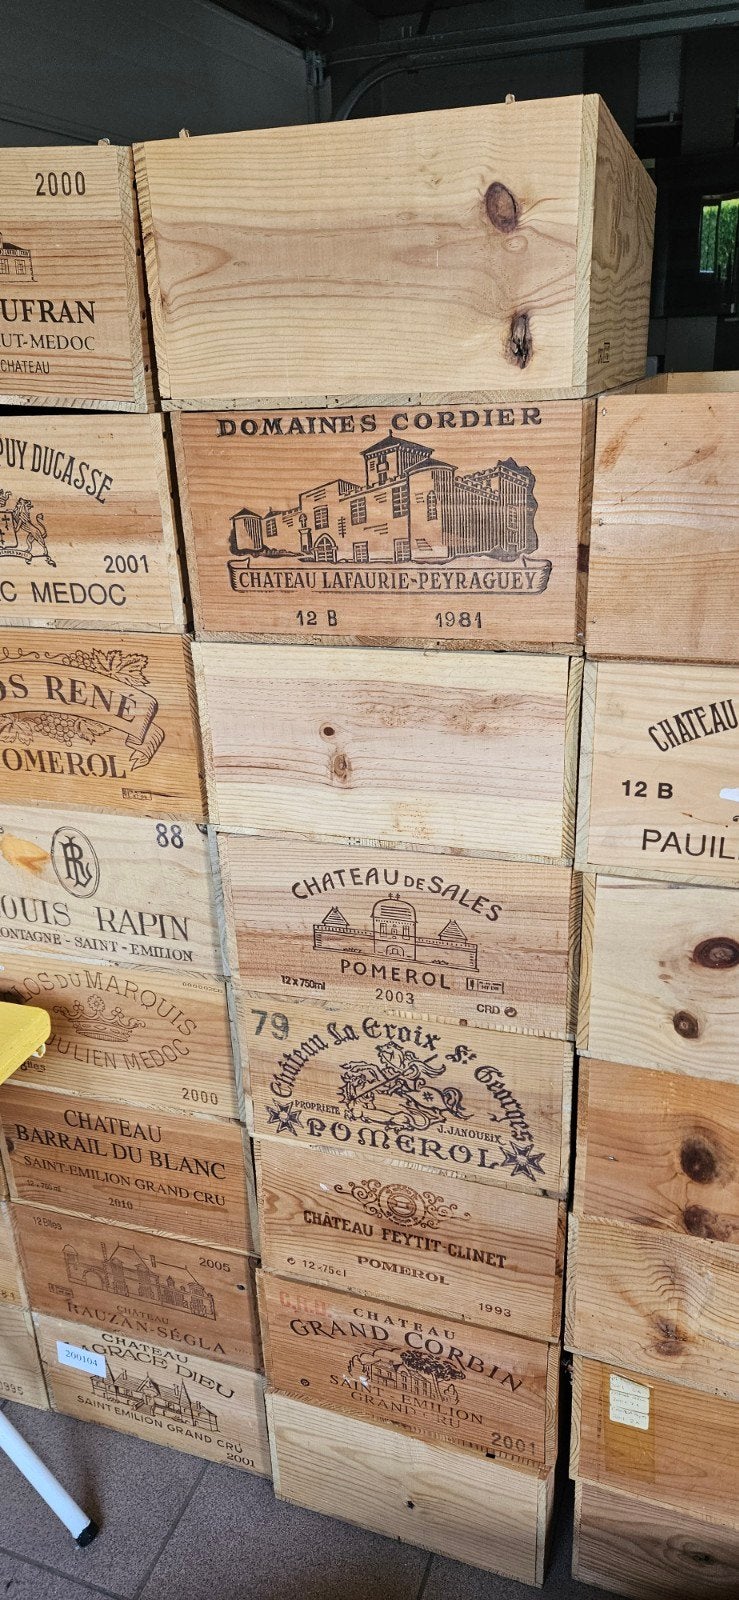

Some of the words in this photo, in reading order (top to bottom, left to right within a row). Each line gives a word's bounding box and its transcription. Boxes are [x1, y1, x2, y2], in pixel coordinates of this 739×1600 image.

[35, 171, 86, 196] 2000
[0, 298, 95, 324] UFRAN
[0, 333, 95, 350] UT-MEDOC
[0, 359, 50, 374] CHATEAU
[216, 414, 377, 438] DOMAINES
[391, 406, 543, 431] CORDIER
[30, 443, 114, 504] DUCASSE
[103, 554, 149, 574] 2001
[0, 580, 17, 602] C
[30, 581, 127, 606] MEDOC
[238, 571, 316, 589] CHATEAU
[322, 571, 538, 590] LAFAURIE-PEYRAGUEY
[296, 609, 318, 627] 12
[327, 609, 338, 627] B
[435, 611, 482, 629] 1981
[43, 675, 138, 723] RENÉ
[648, 699, 739, 752] CHATEAU
[2, 748, 127, 778] OMEROL
[621, 779, 648, 798] 12
[657, 782, 673, 799] B
[155, 822, 184, 849] 88
[641, 828, 739, 860] PAUIL
[291, 867, 399, 900] CHATEAU
[427, 875, 503, 922] SALES
[0, 894, 71, 927] OUIS
[94, 905, 190, 942] RAPIN
[0, 926, 62, 945] ONTAGNE
[74, 936, 119, 953] SAINT
[129, 943, 193, 962] EMILION
[340, 958, 451, 990] POMEROL
[3, 972, 55, 1003] LOS
[83, 969, 198, 1036] MARQUIS
[375, 988, 415, 1005] 2003
[476, 1003, 500, 1015] CRD
[251, 1008, 289, 1041] 79
[122, 1038, 191, 1071] MEDOC
[270, 1034, 329, 1098] Château
[361, 1016, 442, 1051] Croix
[181, 1087, 218, 1105] 2000
[63, 1109, 163, 1143] CHATEAU
[14, 1123, 108, 1158] BARRAIL
[110, 1142, 143, 1164] DU
[147, 1150, 227, 1180] BLANC
[306, 1117, 500, 1170] POMEROL
[23, 1155, 131, 1187] SAINT-EMILION
[134, 1178, 190, 1199] GRAND
[193, 1190, 226, 1207] CRU
[108, 1197, 133, 1210] 2010
[303, 1209, 375, 1237] CHÂTEAU
[381, 1227, 508, 1269] FEYTIT-CLINET
[198, 1257, 231, 1273] 2005
[302, 1259, 316, 1270] 12
[356, 1255, 450, 1286] POMEROL
[352, 1307, 456, 1340] CHATEAU
[478, 1302, 512, 1318] 1993
[66, 1299, 227, 1355] RAUZAN-SÉGLA
[101, 1333, 189, 1364] CHATEAU
[289, 1318, 390, 1342] GRAND
[404, 1331, 523, 1393] CORBIN
[175, 1364, 235, 1400] DIEU
[350, 1391, 417, 1416] GRAND
[401, 1394, 484, 1425] EMILION
[77, 1395, 112, 1414] SAINT
[114, 1407, 163, 1429] EMILION
[166, 1423, 212, 1445] GRAND
[490, 1431, 537, 1456] 2001
[226, 1452, 256, 1469] 2001
